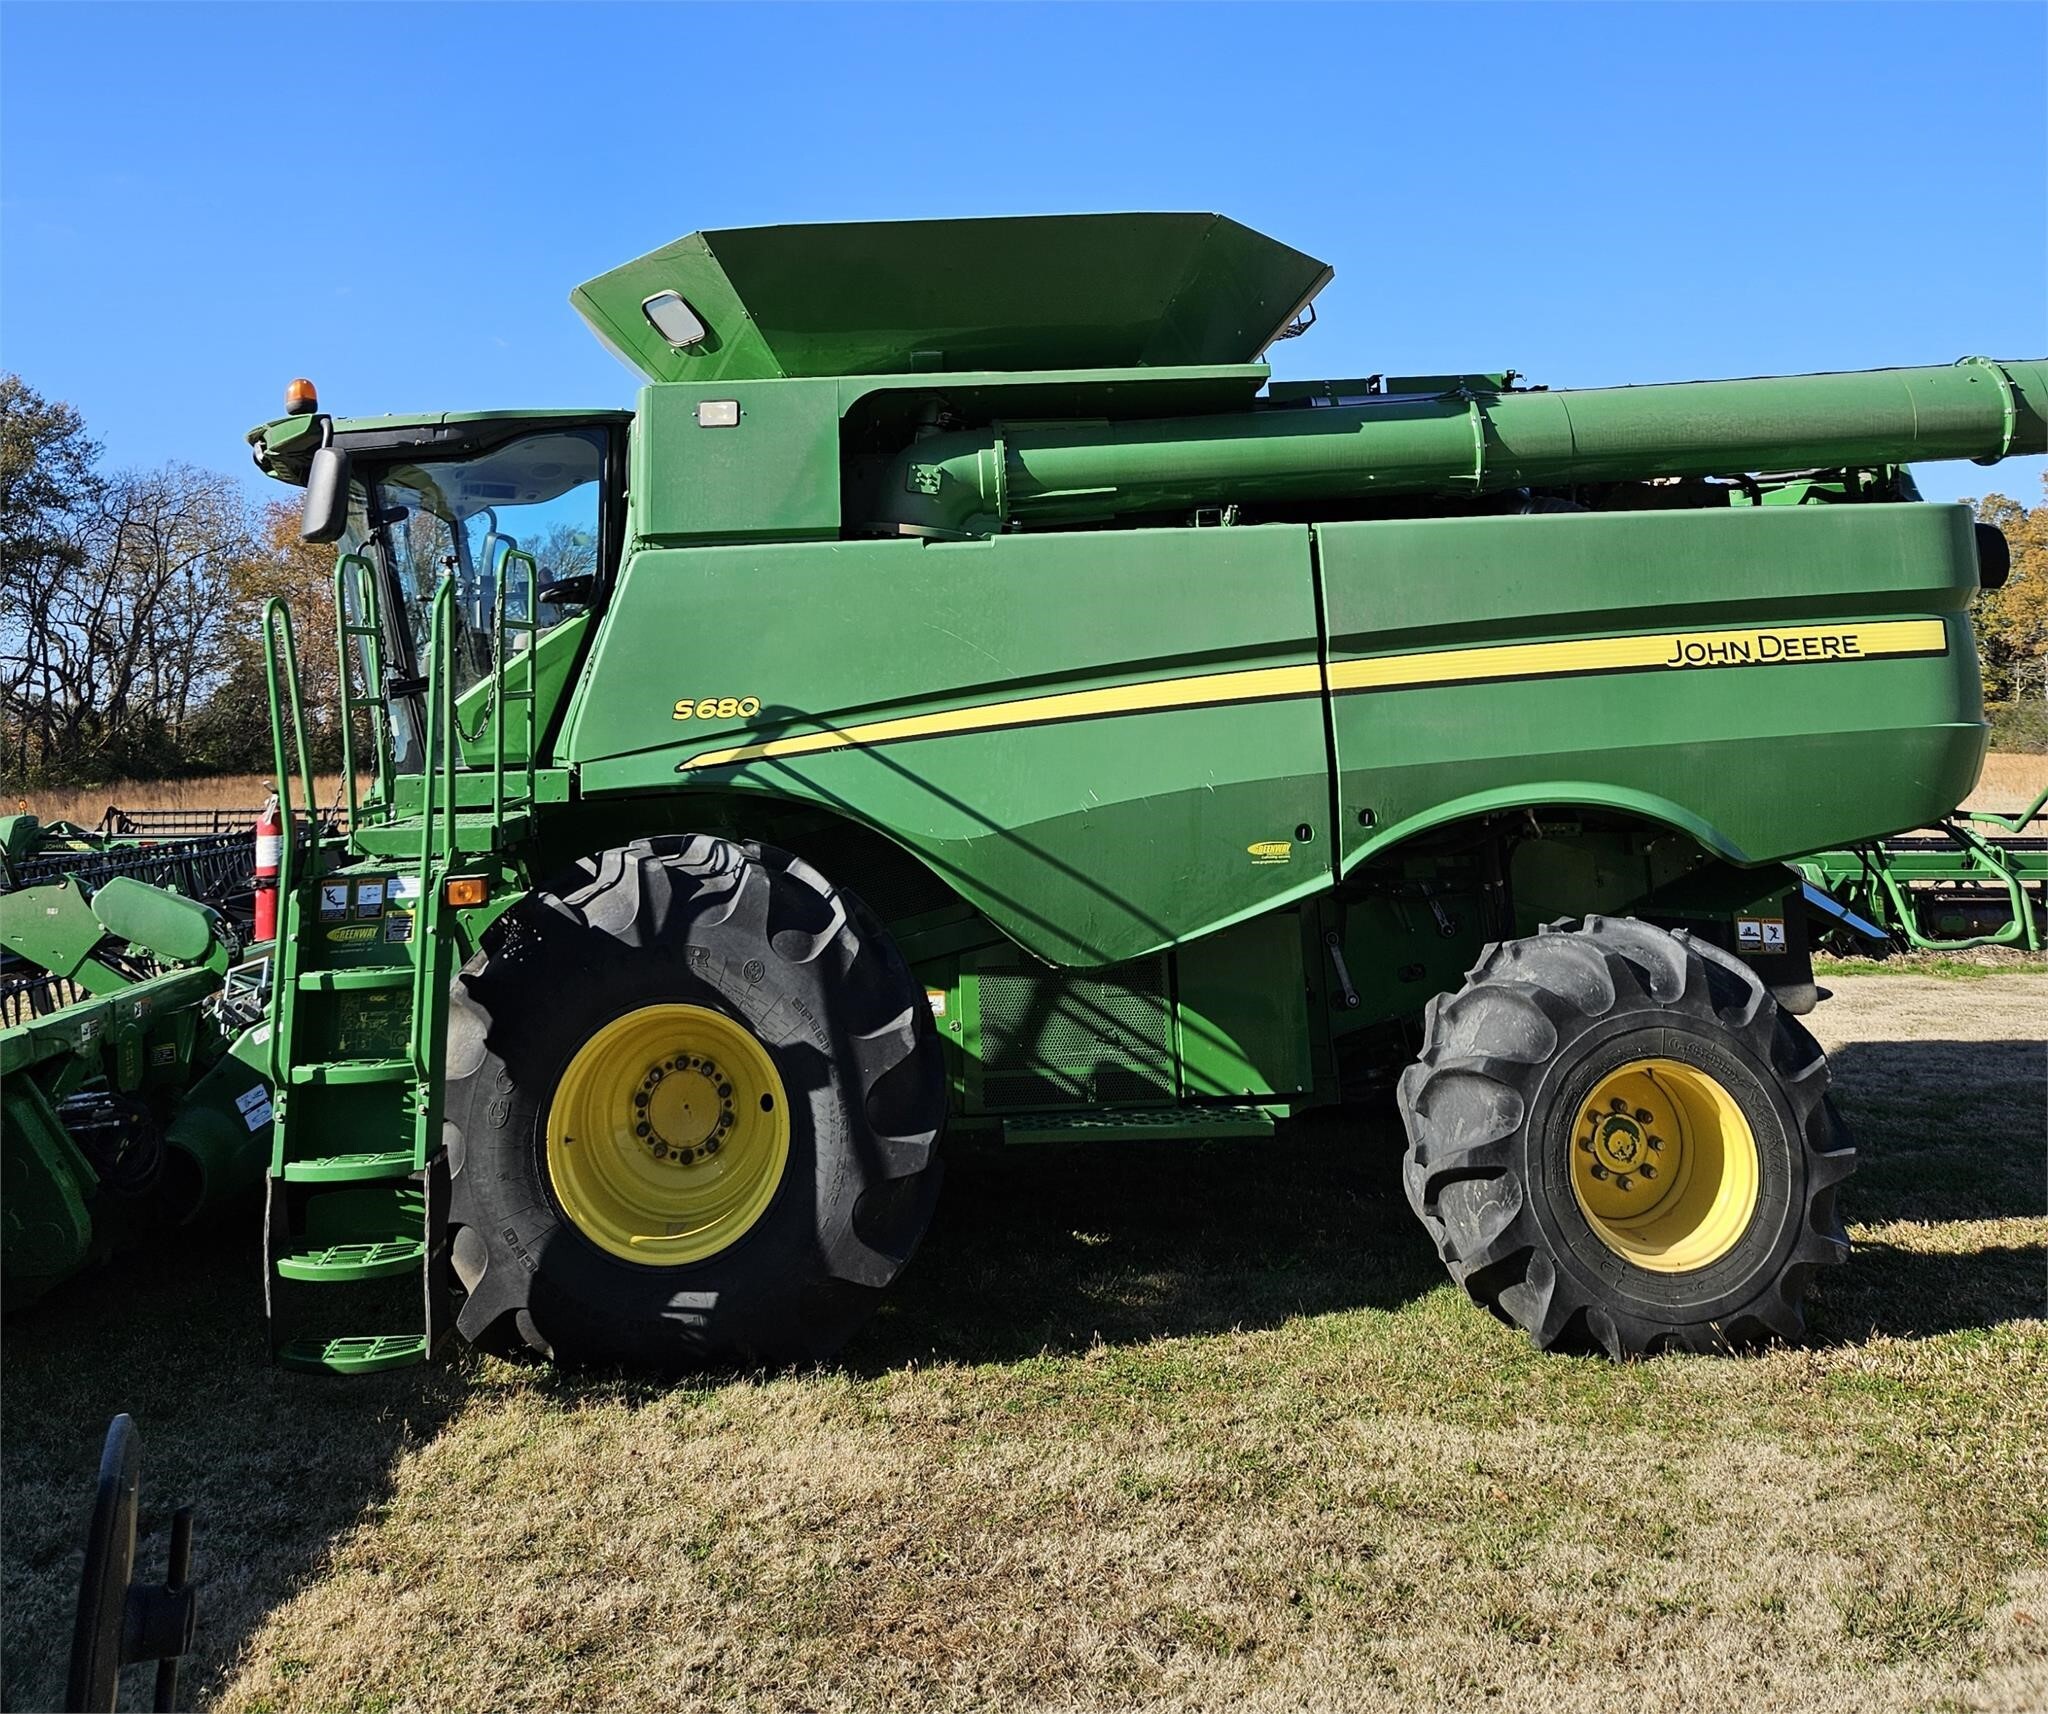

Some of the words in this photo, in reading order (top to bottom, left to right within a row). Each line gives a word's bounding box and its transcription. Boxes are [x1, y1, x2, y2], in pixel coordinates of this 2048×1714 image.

[1667, 639, 1751, 664] JOHN
[1757, 634, 1861, 659] DEERE
[672, 696, 761, 721] S680
[334, 926, 379, 940] GREENWAY
